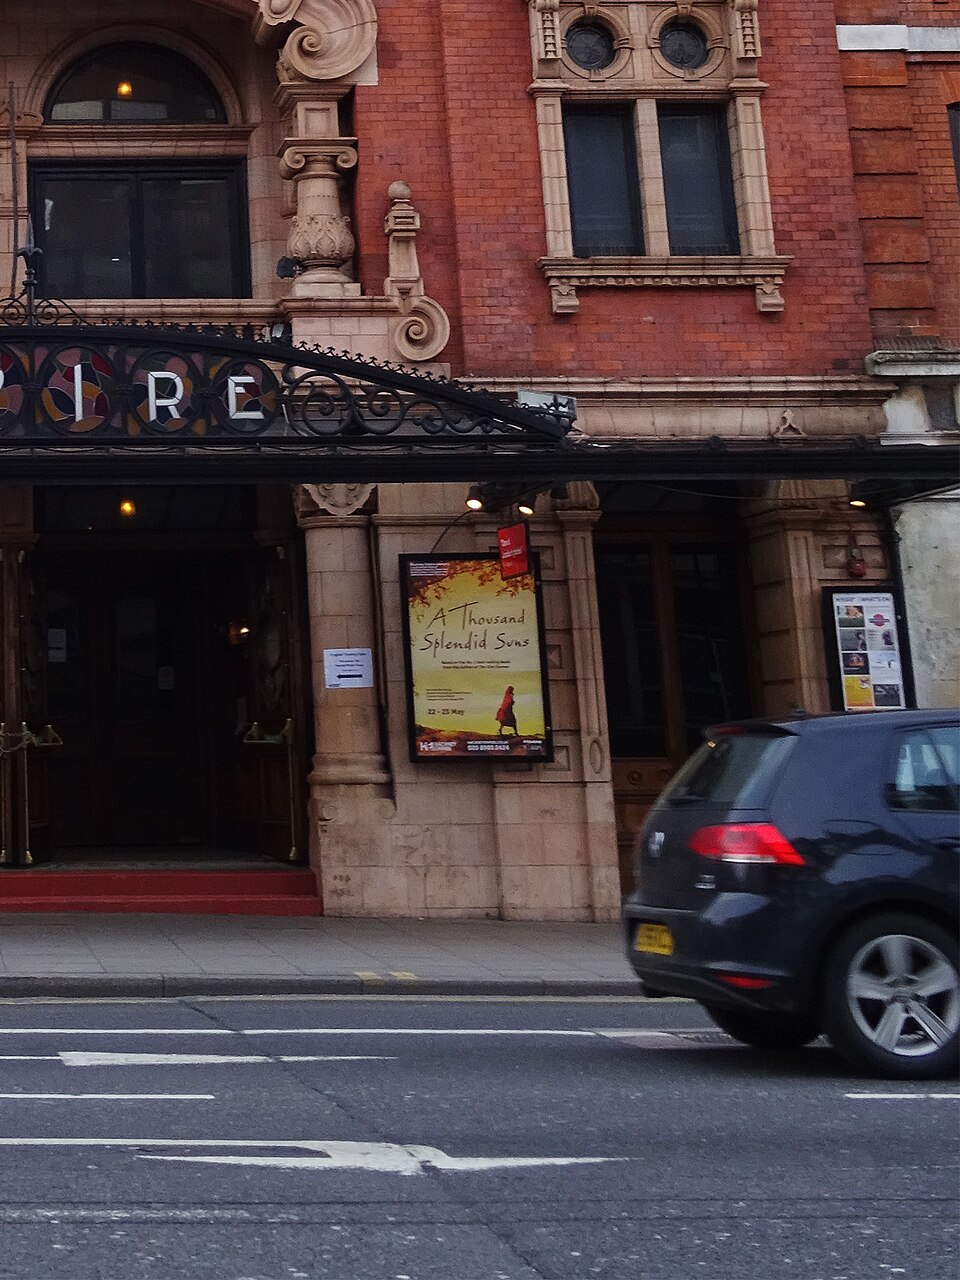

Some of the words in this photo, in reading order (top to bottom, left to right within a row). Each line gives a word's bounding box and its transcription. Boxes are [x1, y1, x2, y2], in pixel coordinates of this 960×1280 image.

[426, 607, 447, 630] A
[448, 601, 526, 630] Thousand
[420, 629, 487, 658] Splendid
[494, 632, 530, 650] Suns
[451, 708, 465, 716] May
